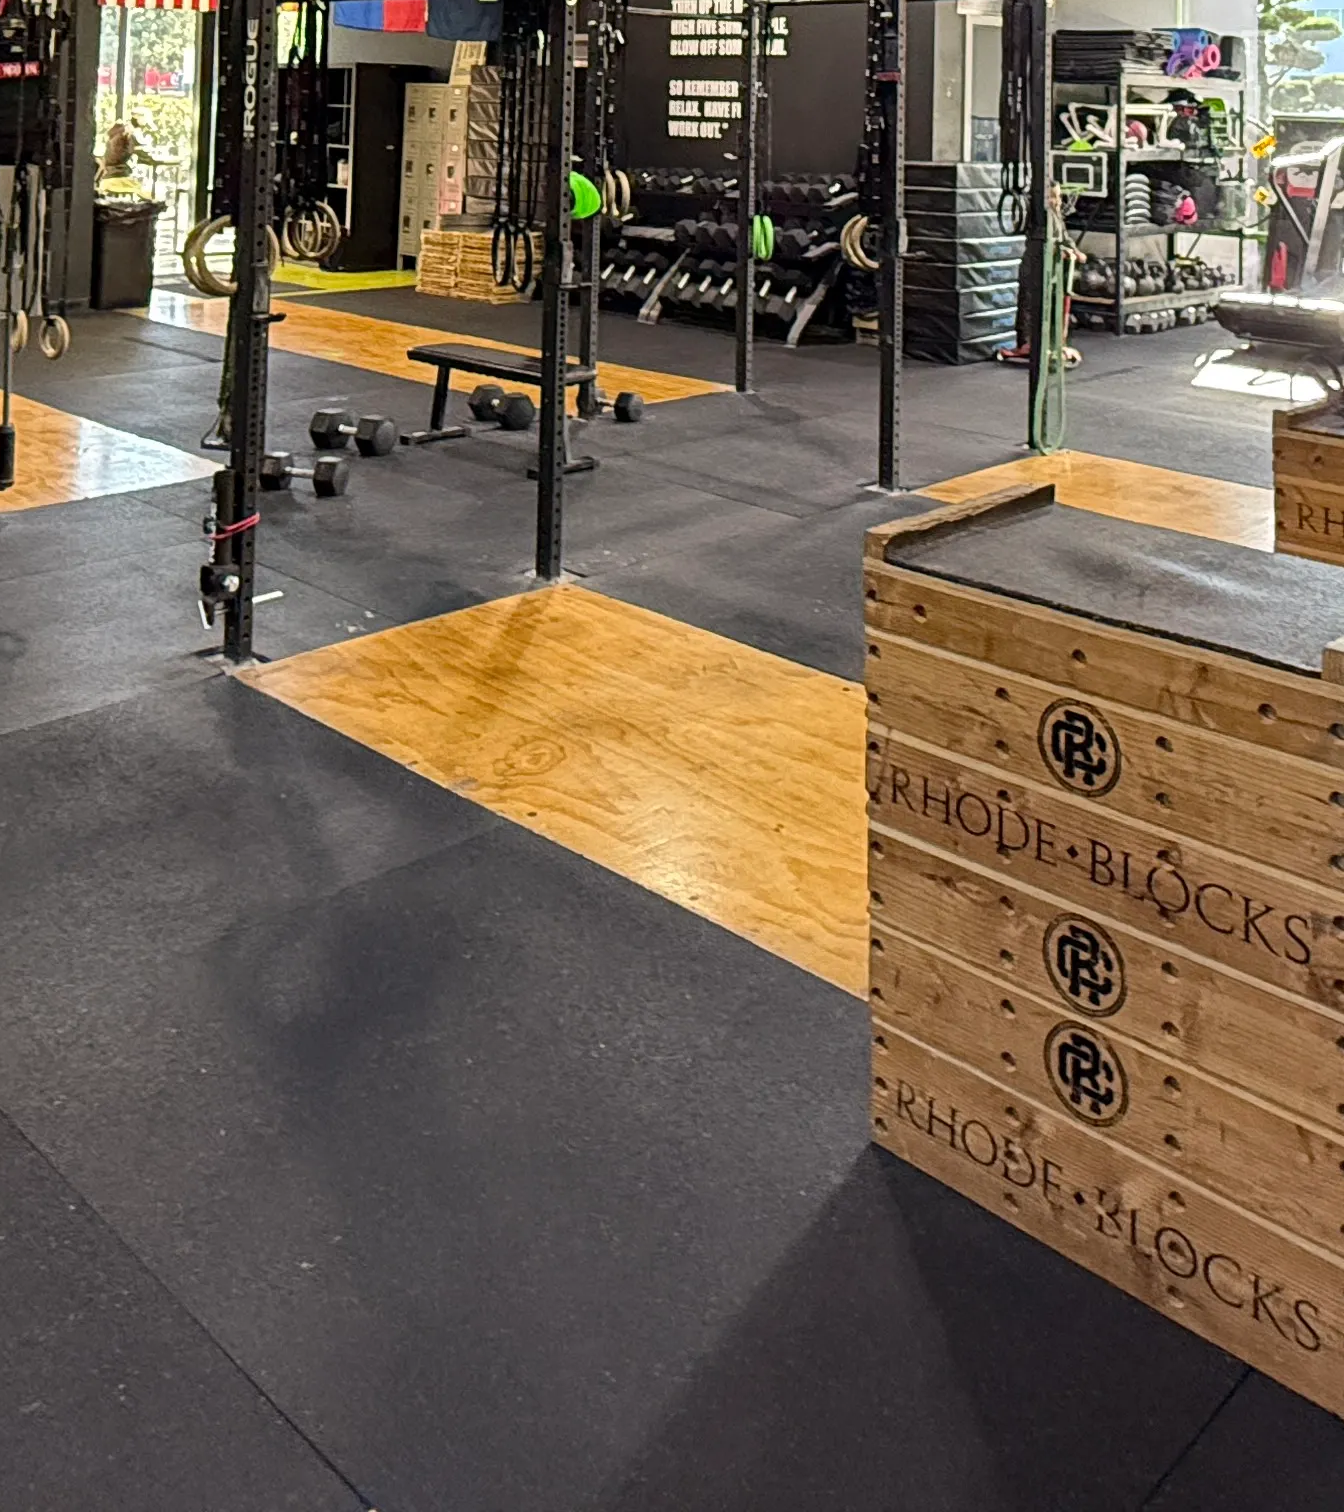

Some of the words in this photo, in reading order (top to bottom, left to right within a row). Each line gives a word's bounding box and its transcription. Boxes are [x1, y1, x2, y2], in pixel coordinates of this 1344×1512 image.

[670, 39, 699, 56] BLOW
[243, 18, 259, 132] ROGUE
[684, 80, 739, 97] REMEMBER
